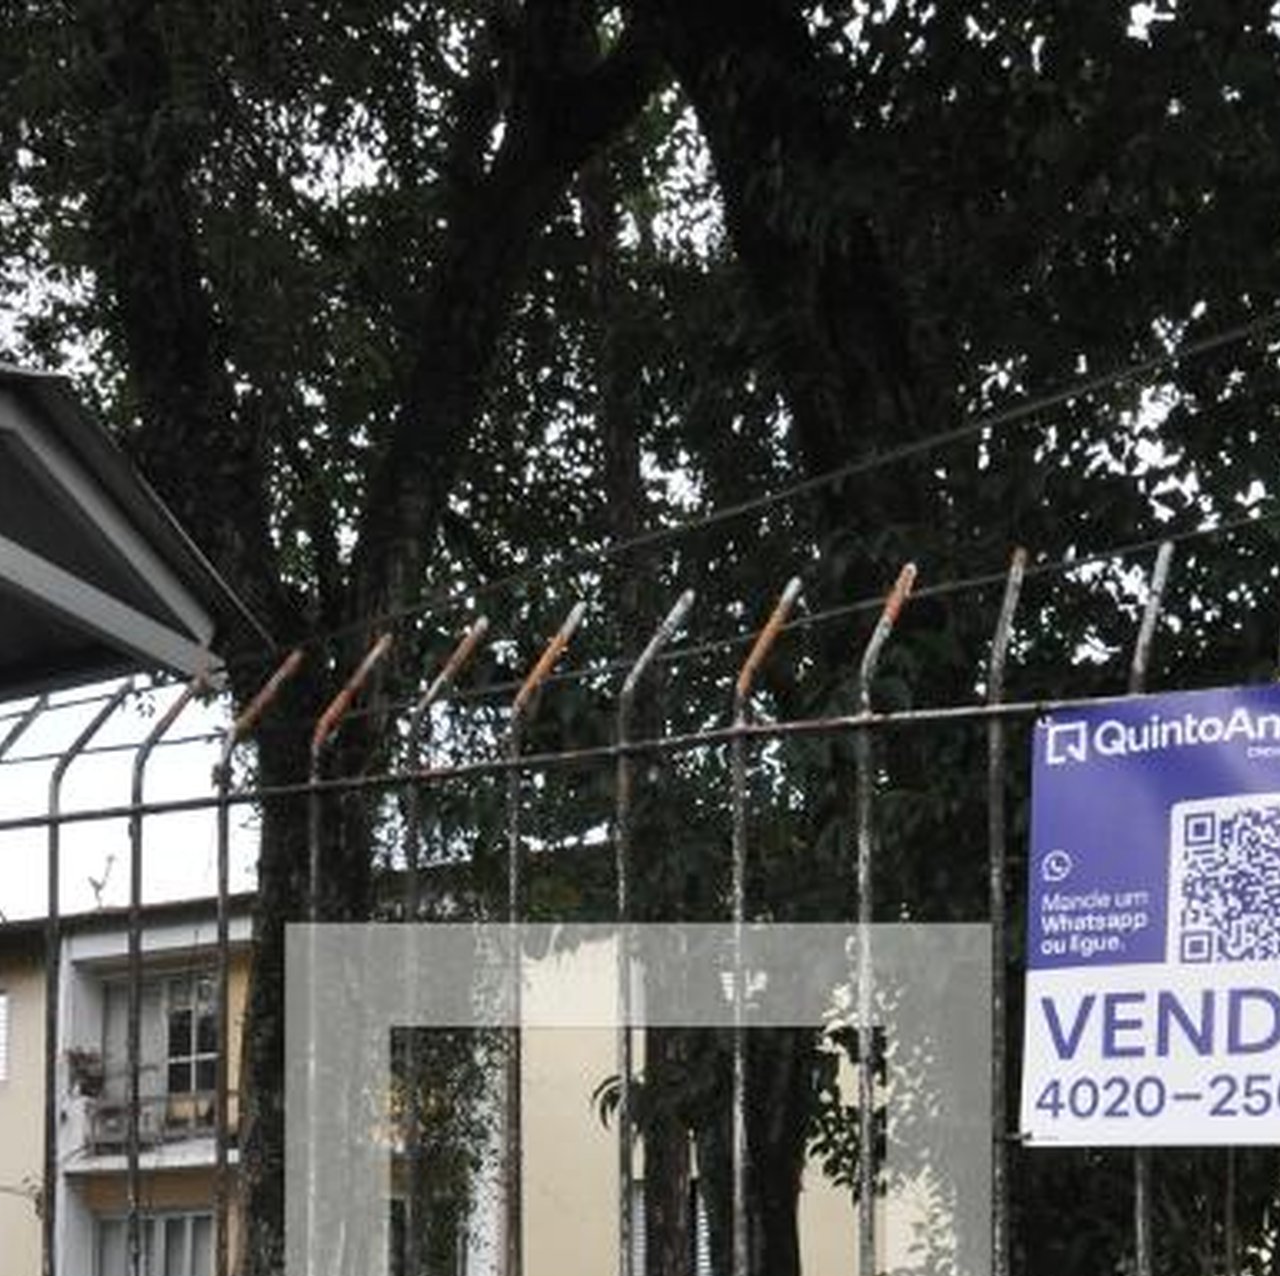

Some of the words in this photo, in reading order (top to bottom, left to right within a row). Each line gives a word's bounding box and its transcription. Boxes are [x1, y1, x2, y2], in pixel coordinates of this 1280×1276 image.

[1040, 889, 1111, 912] Mande
[1114, 891, 1149, 908] um
[1041, 939, 1066, 955] ou
